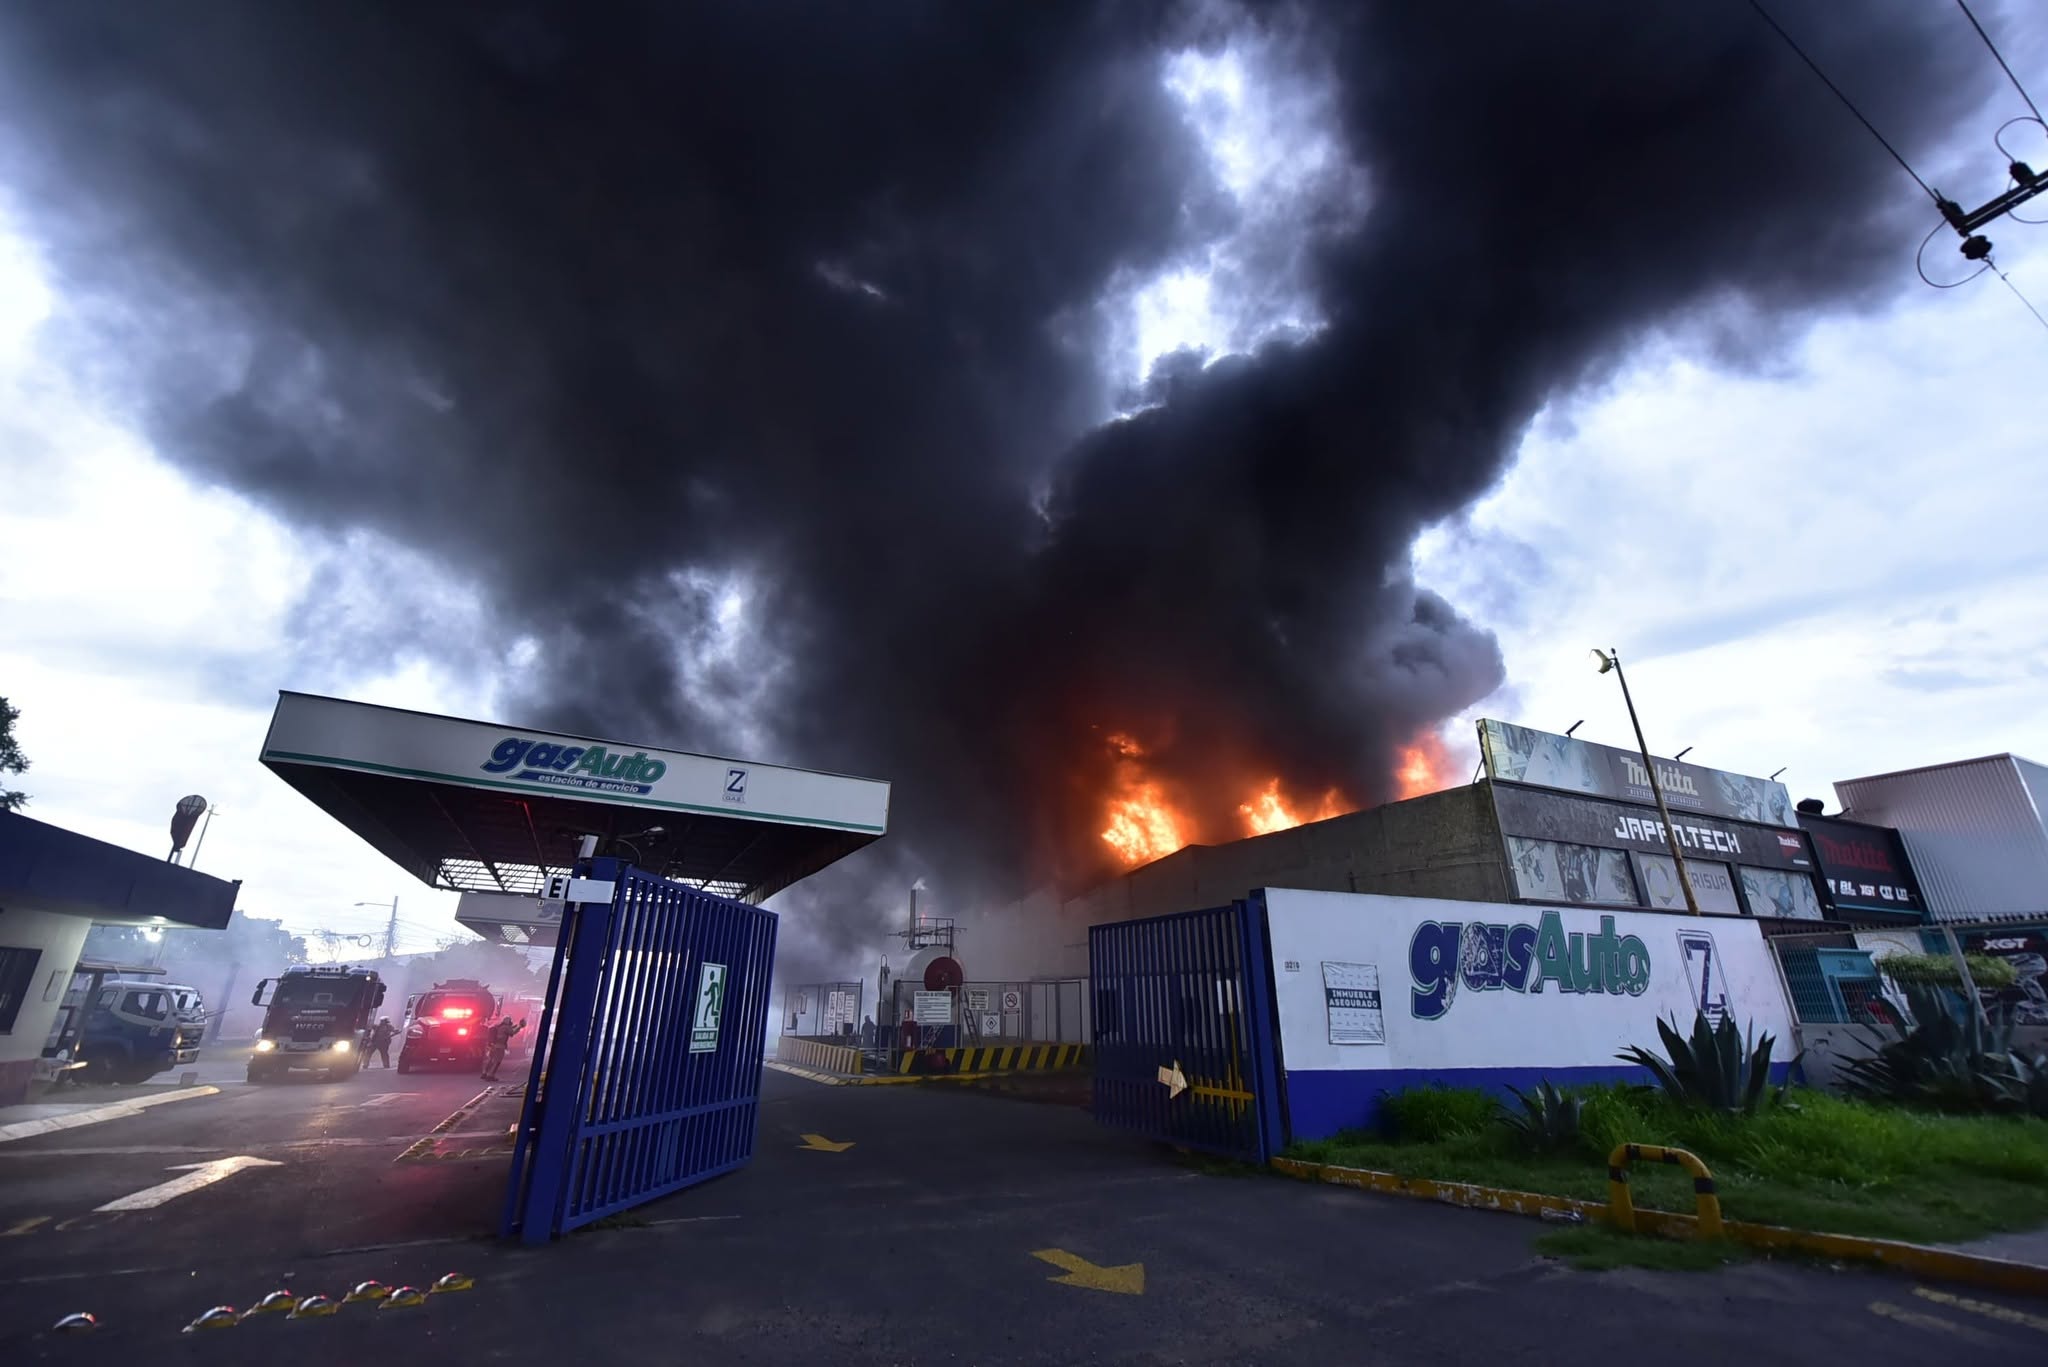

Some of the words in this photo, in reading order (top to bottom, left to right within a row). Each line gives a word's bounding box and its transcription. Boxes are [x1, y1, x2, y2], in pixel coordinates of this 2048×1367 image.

[480, 737, 667, 784] gasAuto
[538, 774, 583, 786] estación
[585, 779, 598, 788] de
[600, 781, 639, 793] servicio
[727, 770, 746, 793] Z
[1620, 756, 1699, 796] Mkita
[548, 878, 564, 898] E
[1983, 937, 2028, 950] XGT
[1408, 911, 1650, 1021] gasAuto
[1329, 998, 1378, 1008] ASEGURADO
[1332, 989, 1373, 999] INMUEBLE
